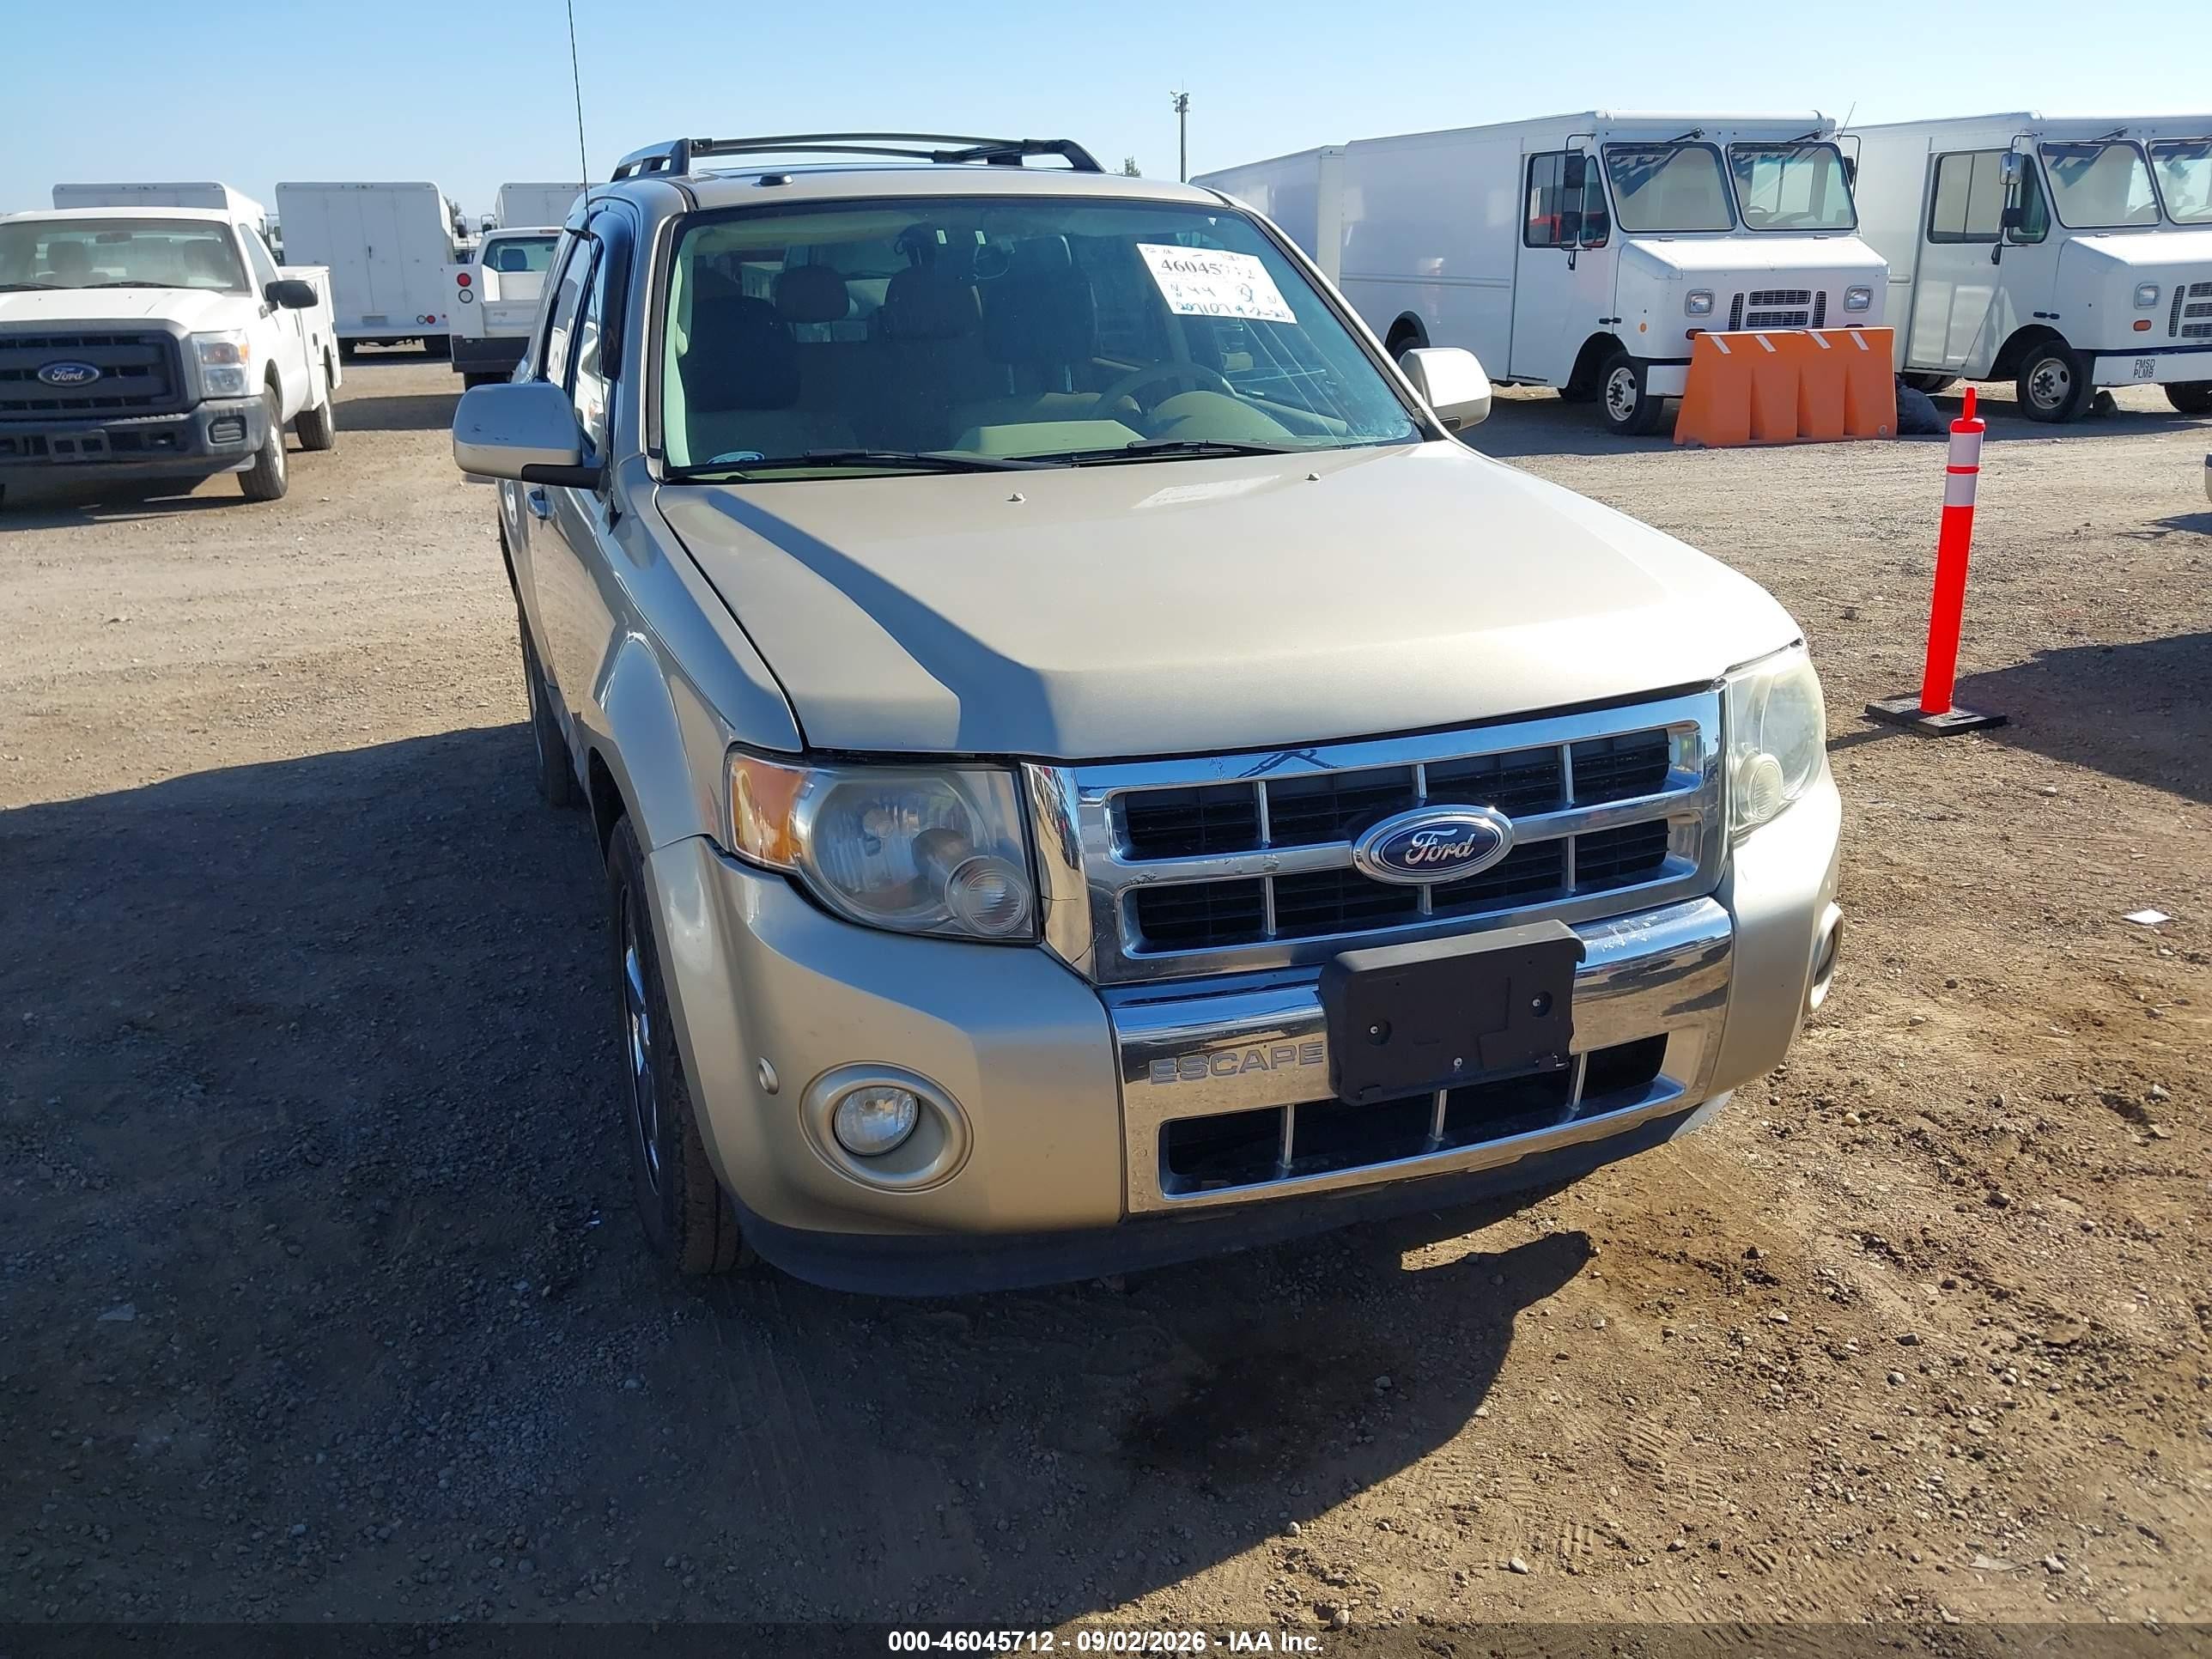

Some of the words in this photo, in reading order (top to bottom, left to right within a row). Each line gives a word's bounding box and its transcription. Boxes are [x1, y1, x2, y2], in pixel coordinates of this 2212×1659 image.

[2135, 358, 2156, 369] FMSD
[52, 367, 84, 381] Ford
[2133, 368, 2154, 379] PLMB
[1405, 828, 1477, 866] Ford
[1149, 1040, 1325, 1085] ESCAPE
